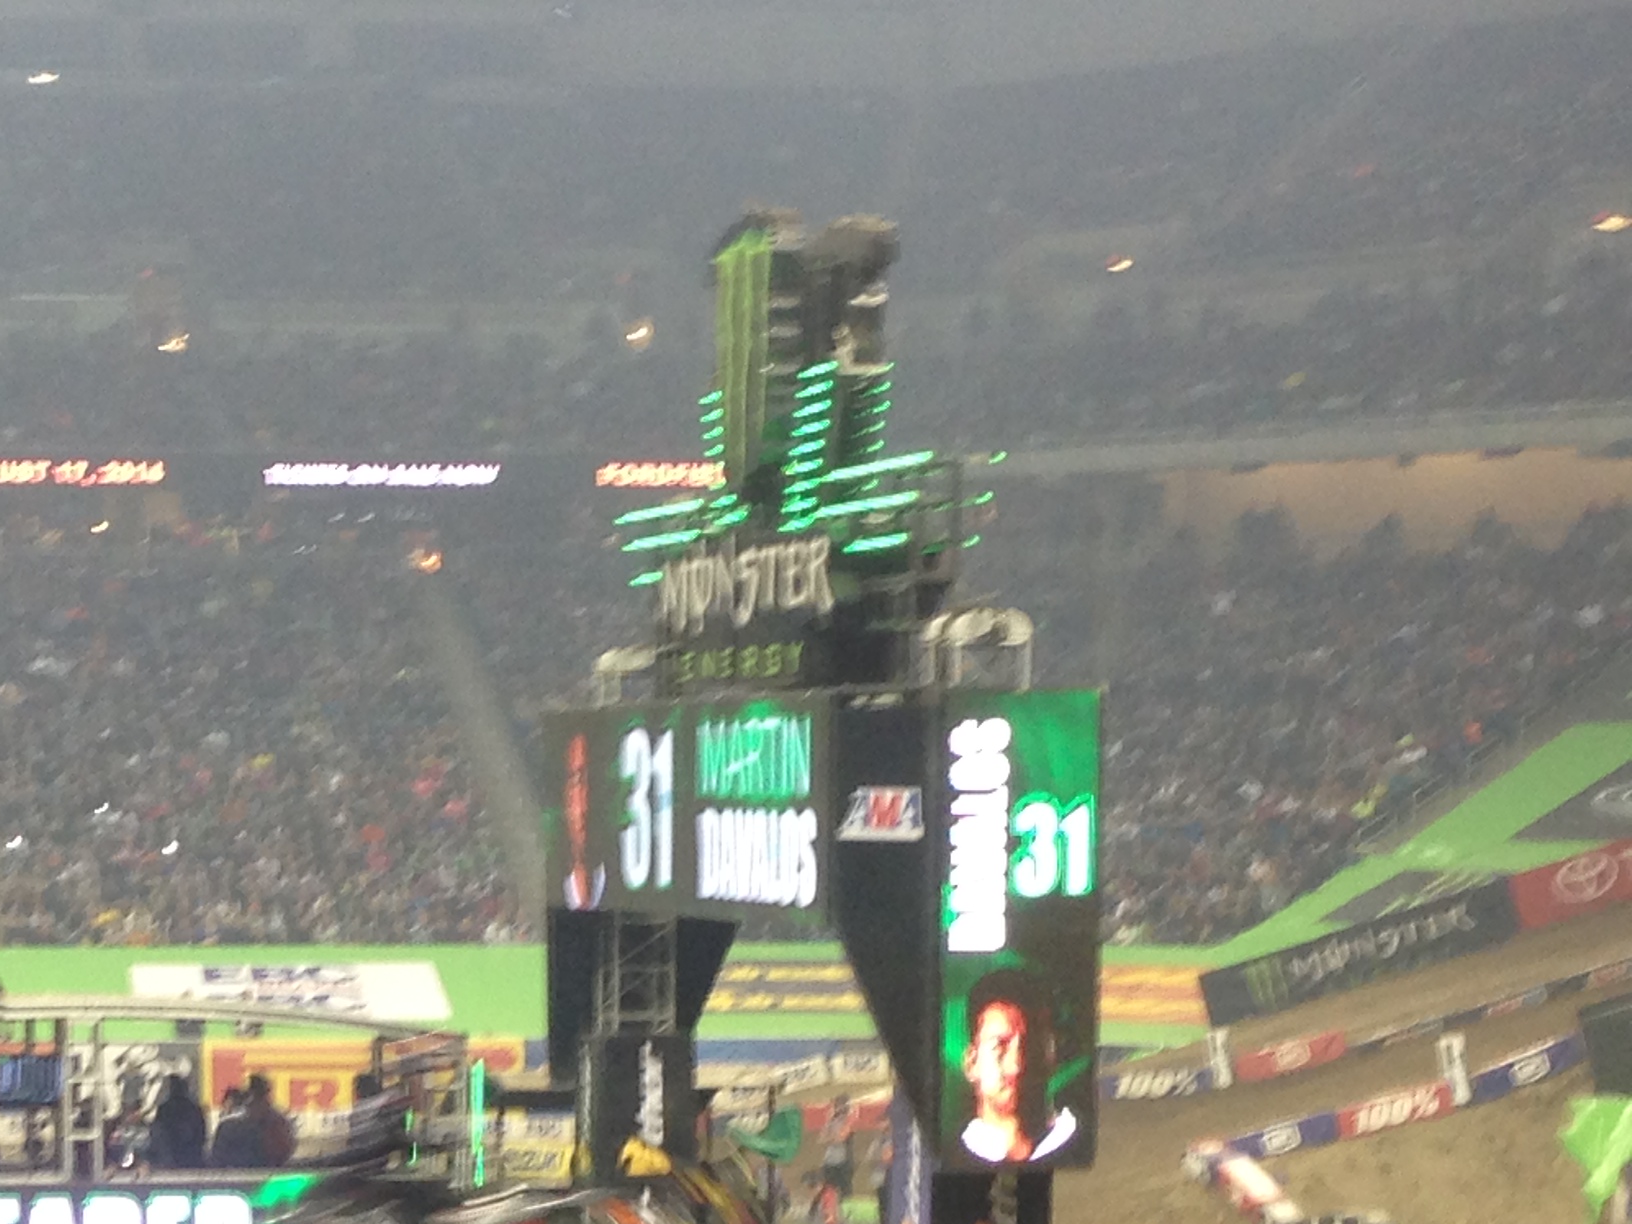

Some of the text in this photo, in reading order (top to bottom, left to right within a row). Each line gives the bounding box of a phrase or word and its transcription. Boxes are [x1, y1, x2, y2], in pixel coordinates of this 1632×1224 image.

[657, 534, 835, 636] MONSTER
[618, 726, 674, 889] 31
[1011, 791, 1096, 897] 31
